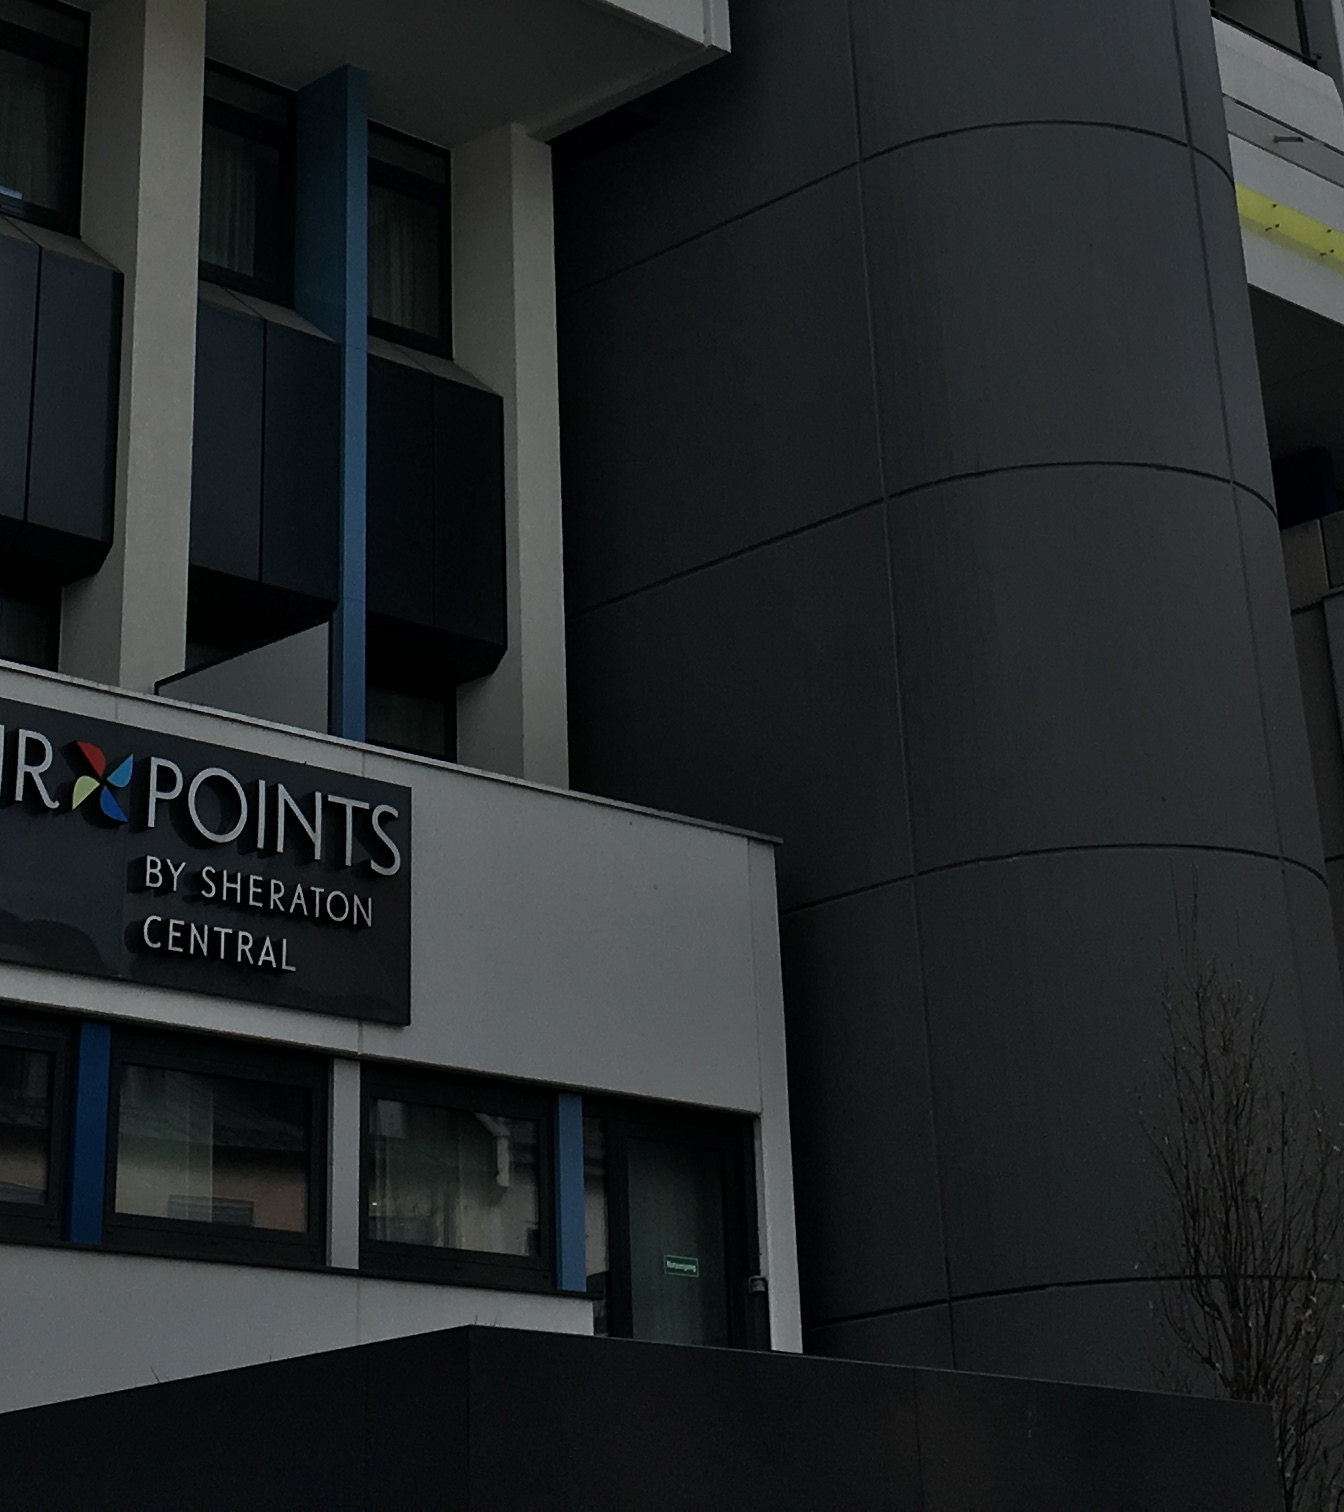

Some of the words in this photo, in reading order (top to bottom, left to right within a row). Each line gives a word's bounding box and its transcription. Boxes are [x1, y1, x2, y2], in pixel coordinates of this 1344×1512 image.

[147, 756, 402, 877] POINTS
[144, 855, 187, 891] BY
[201, 866, 374, 928] SHERATON
[143, 915, 297, 972] CENTRAL
